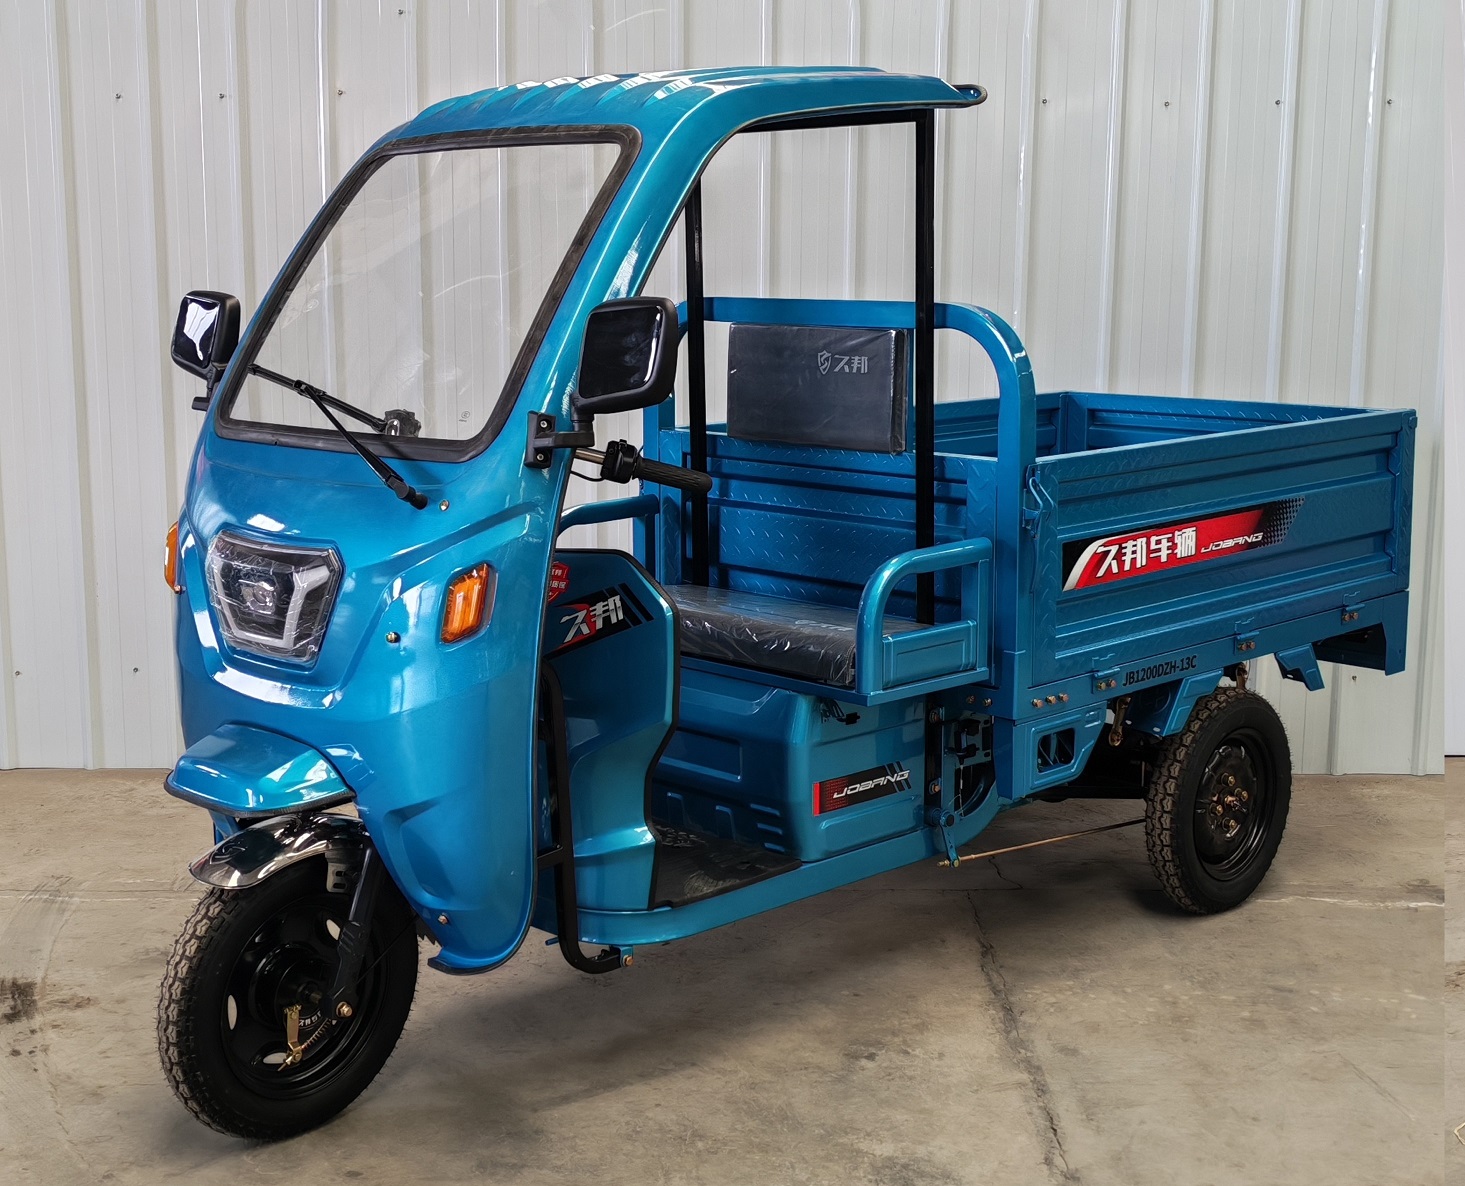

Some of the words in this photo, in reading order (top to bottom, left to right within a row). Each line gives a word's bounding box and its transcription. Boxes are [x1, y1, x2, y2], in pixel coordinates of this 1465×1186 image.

[833, 354, 868, 374] 久邦
[1095, 526, 1197, 578] 久邦车辆
[1200, 532, 1264, 554] JOBANG
[560, 595, 624, 643] 久邦
[1122, 654, 1198, 687] JB1200DZH-13C
[832, 769, 910, 799] JOBANG
